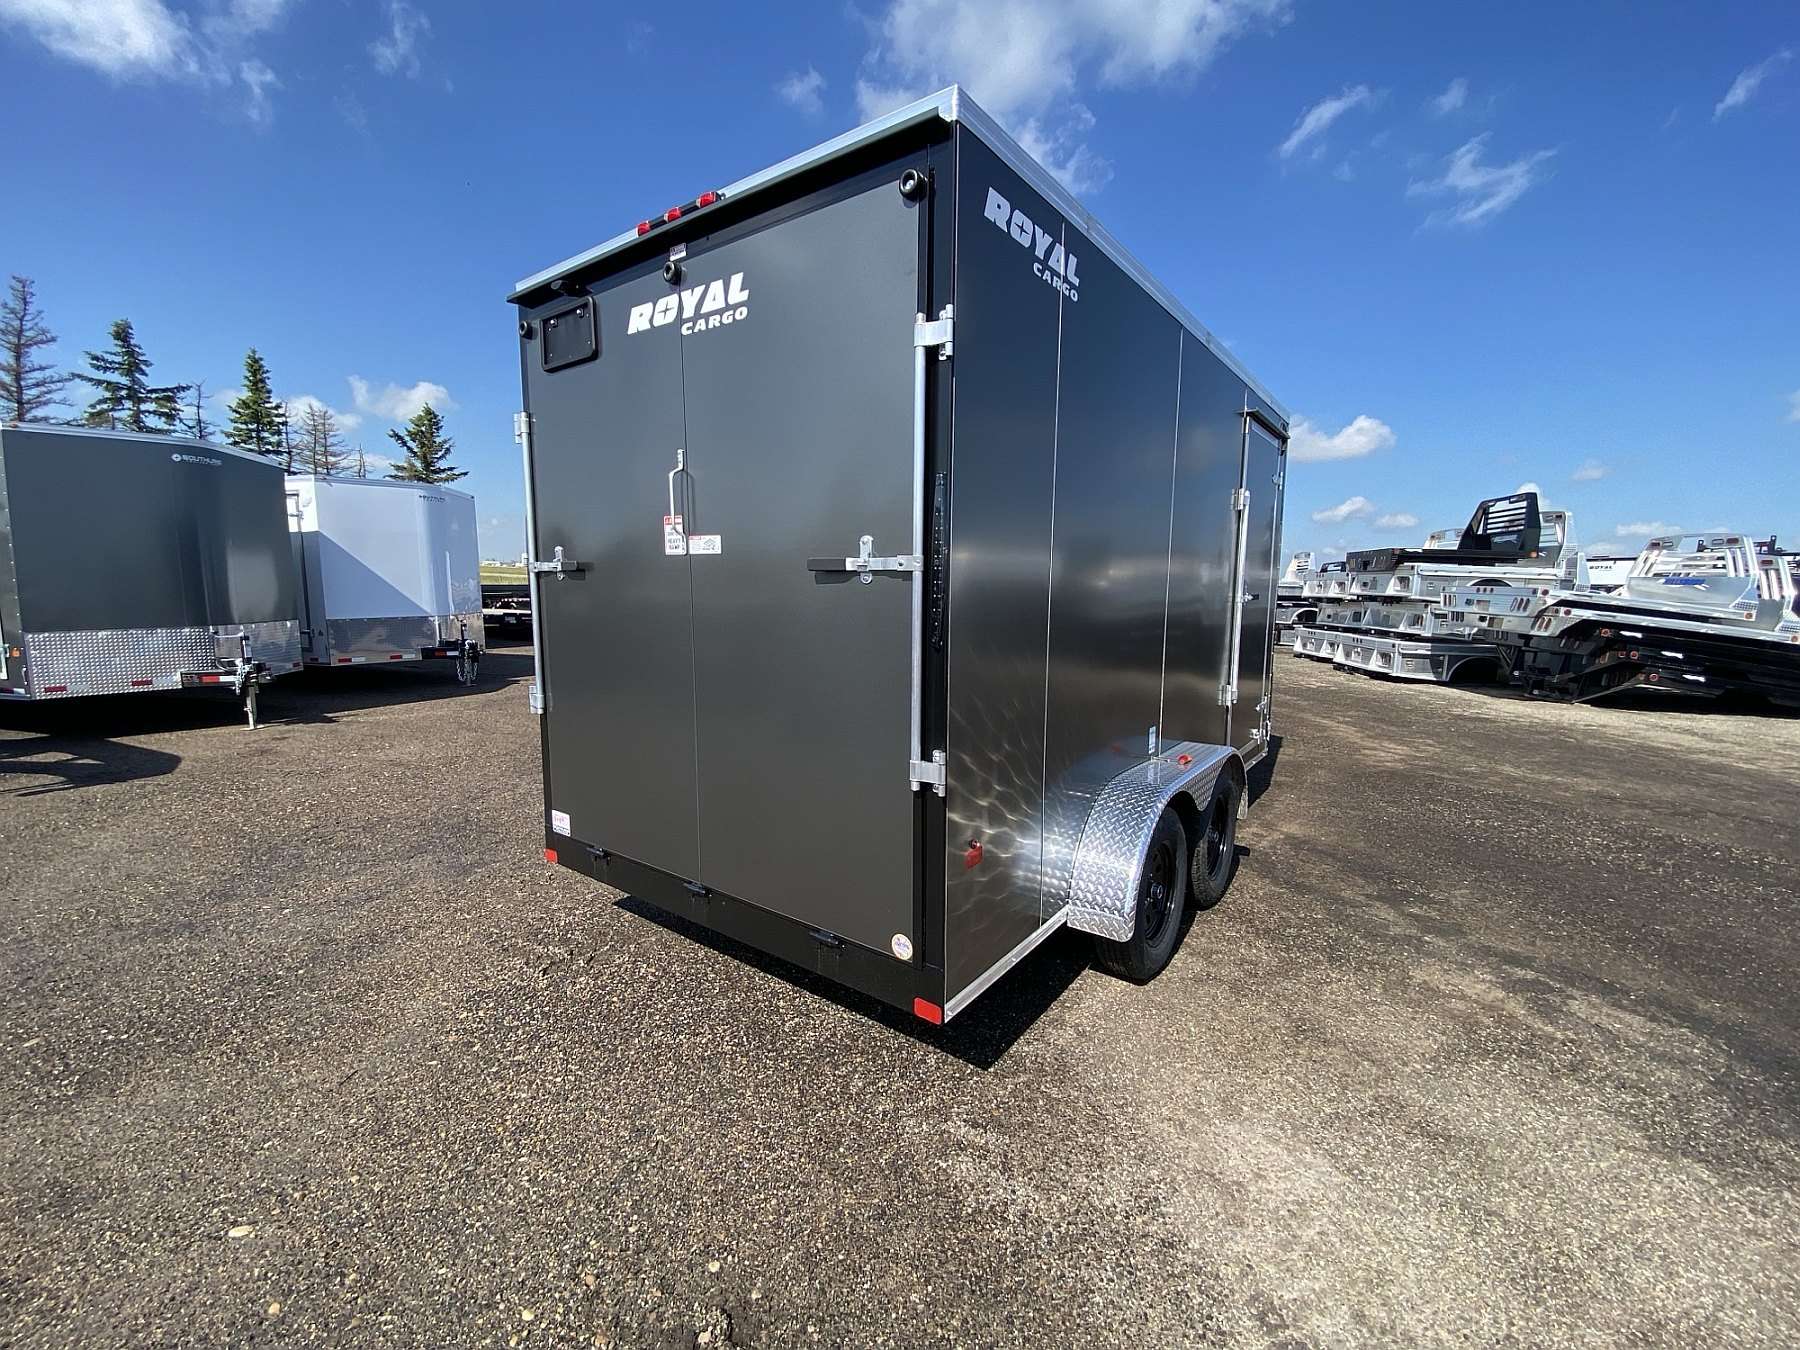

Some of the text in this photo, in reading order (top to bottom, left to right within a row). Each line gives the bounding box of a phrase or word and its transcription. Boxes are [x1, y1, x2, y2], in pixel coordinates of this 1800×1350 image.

[984, 187, 1079, 287] ROYAL
[627, 272, 749, 335] ROYAL
[1033, 262, 1079, 302] CARGO
[681, 306, 748, 335] CARGO
